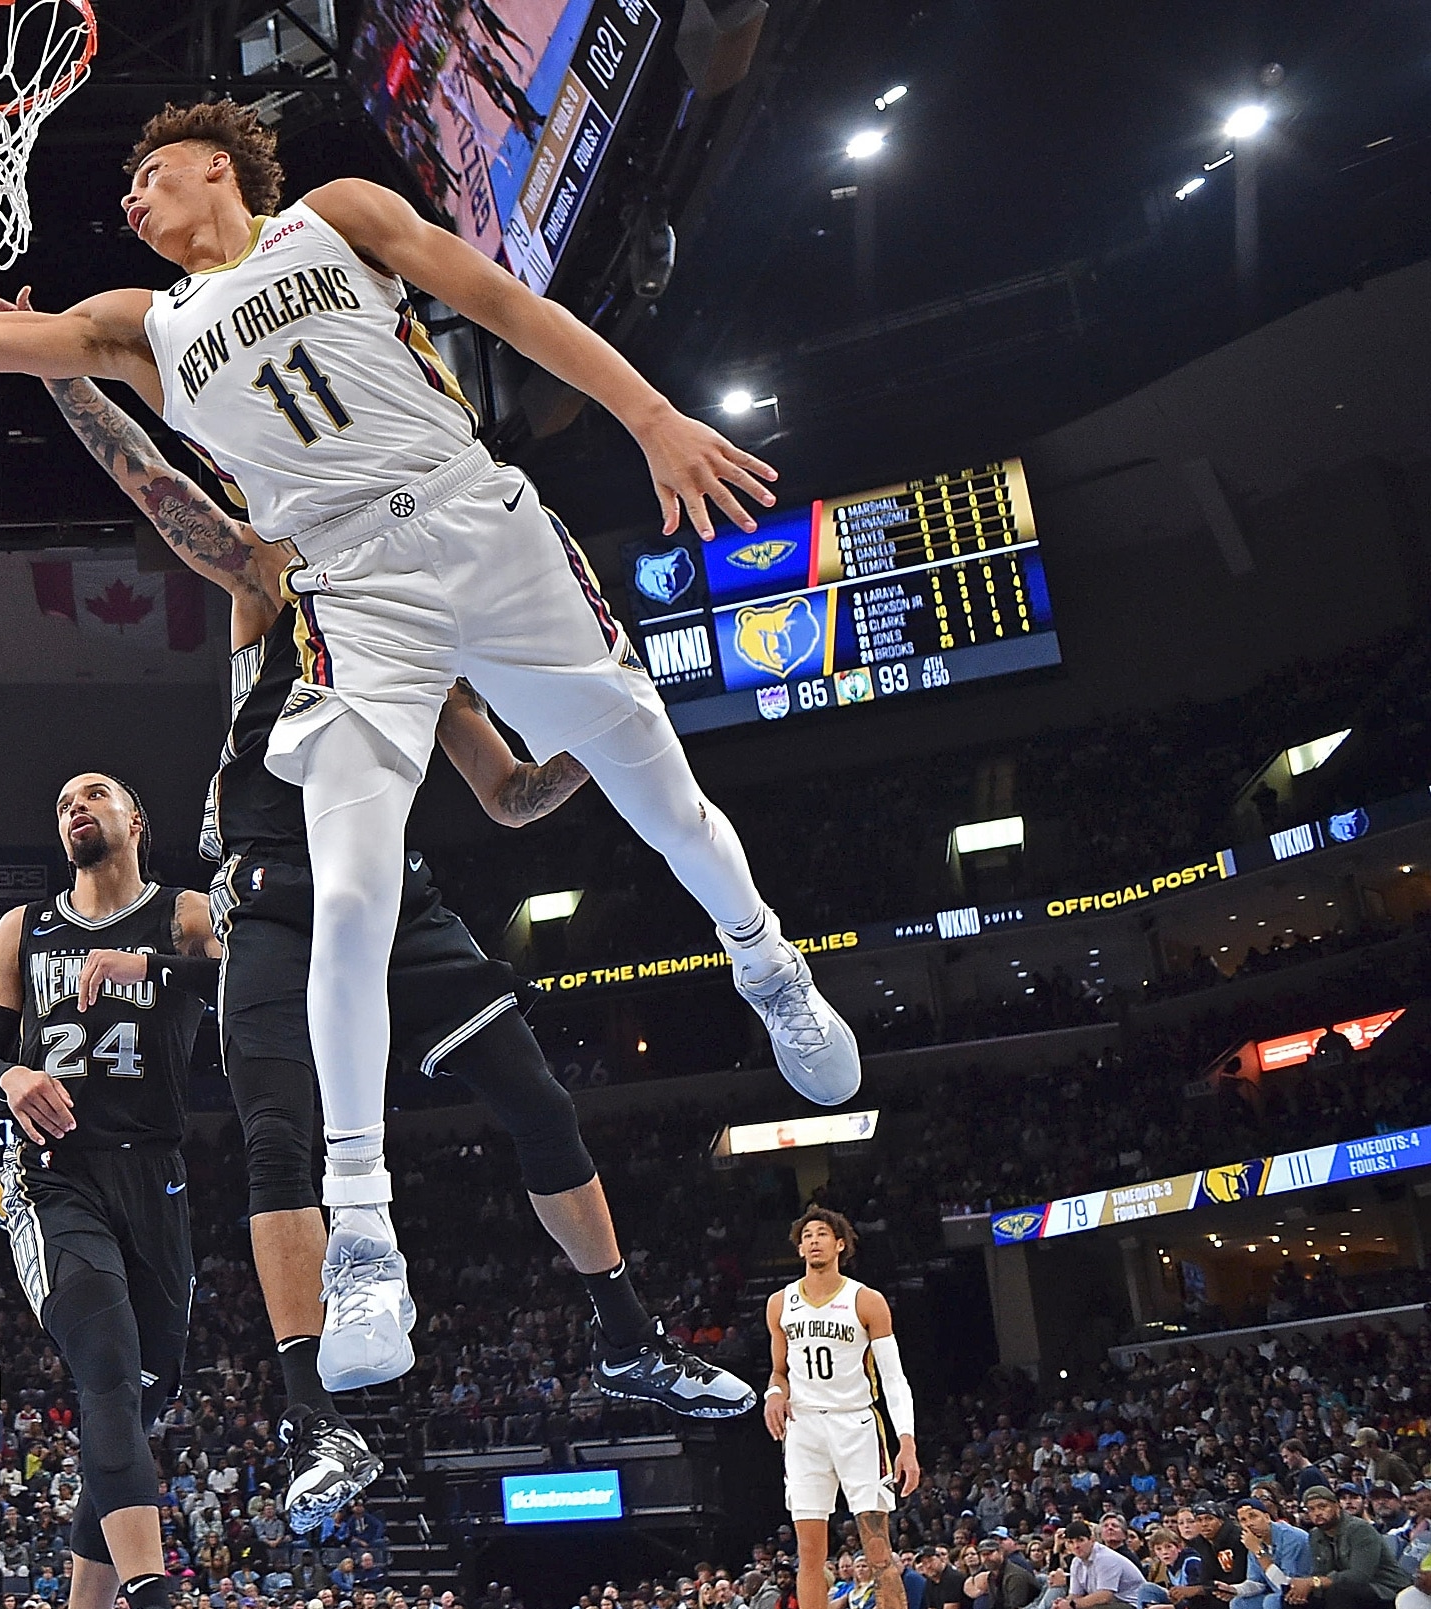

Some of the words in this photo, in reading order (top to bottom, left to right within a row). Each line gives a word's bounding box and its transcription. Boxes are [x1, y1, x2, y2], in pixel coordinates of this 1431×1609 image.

[586, 16, 627, 90] 10:21
[261, 220, 305, 253] ibotta
[176, 320, 231, 405] NEW
[232, 267, 361, 347] ORLEANS
[252, 341, 354, 447] 11
[855, 541, 896, 561] DANIELS
[859, 556, 895, 574] TEMPLE
[864, 584, 904, 604] LARAVIA
[867, 598, 910, 617] JACKSON
[869, 613, 906, 632] CLARKE
[873, 629, 902, 647] JONES
[645, 625, 711, 677] WKND
[874, 642, 914, 661] BROOKS
[922, 656, 944, 673] 4TH
[879, 663, 909, 694] 93
[798, 679, 828, 710] 85
[1271, 823, 1314, 861] WKND
[1047, 884, 1149, 917] OFFICIAL
[937, 907, 980, 939] WKND
[559, 972, 587, 990] OF
[591, 967, 634, 984] THE
[41, 1022, 144, 1079] 24
[1062, 1200, 1088, 1229] 79
[809, 1320, 855, 1343] ORLEANS
[803, 1346, 834, 1380] 10
